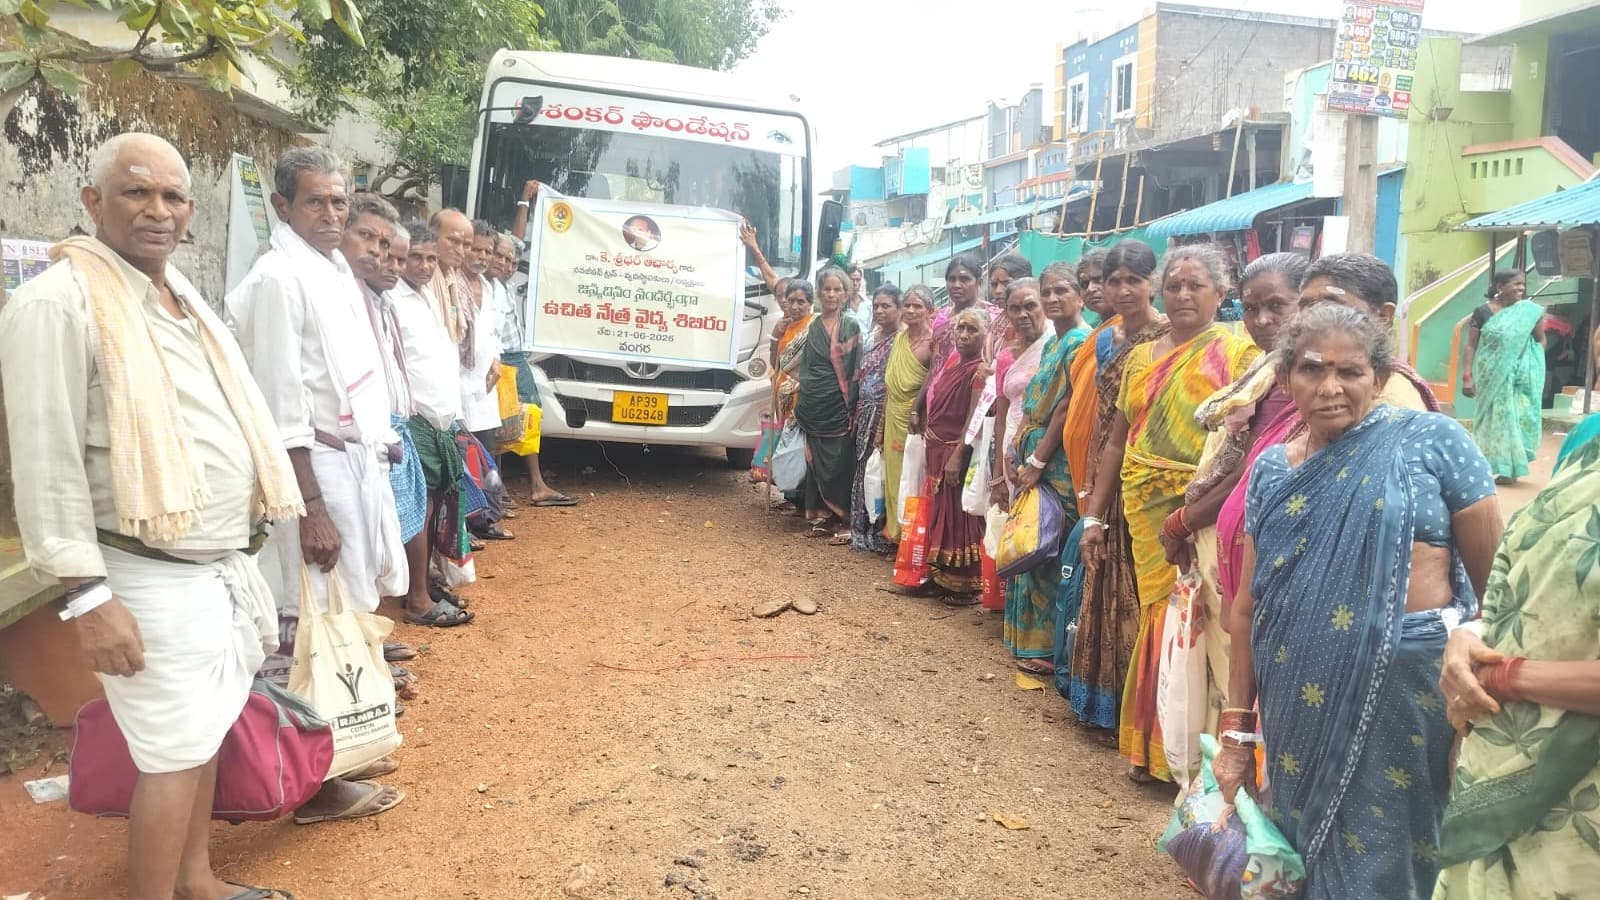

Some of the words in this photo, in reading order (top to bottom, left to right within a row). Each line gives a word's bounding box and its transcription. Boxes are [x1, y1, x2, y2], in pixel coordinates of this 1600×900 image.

[1348, 64, 1378, 83] 462
[540, 103, 625, 125] శంకర్
[631, 111, 753, 143] ఫౌండేషన్
[578, 283, 631, 301] జన్మదినం
[543, 300, 592, 319] ఉచిత
[596, 302, 631, 324] నేత్ర
[635, 308, 668, 332] వైద్య
[672, 313, 727, 332] శిబిరం
[618, 341, 651, 354] వంగర
[630, 395, 658, 408] AP39
[621, 407, 664, 421] UG2948
[339, 704, 390, 727] RAMRAJ
